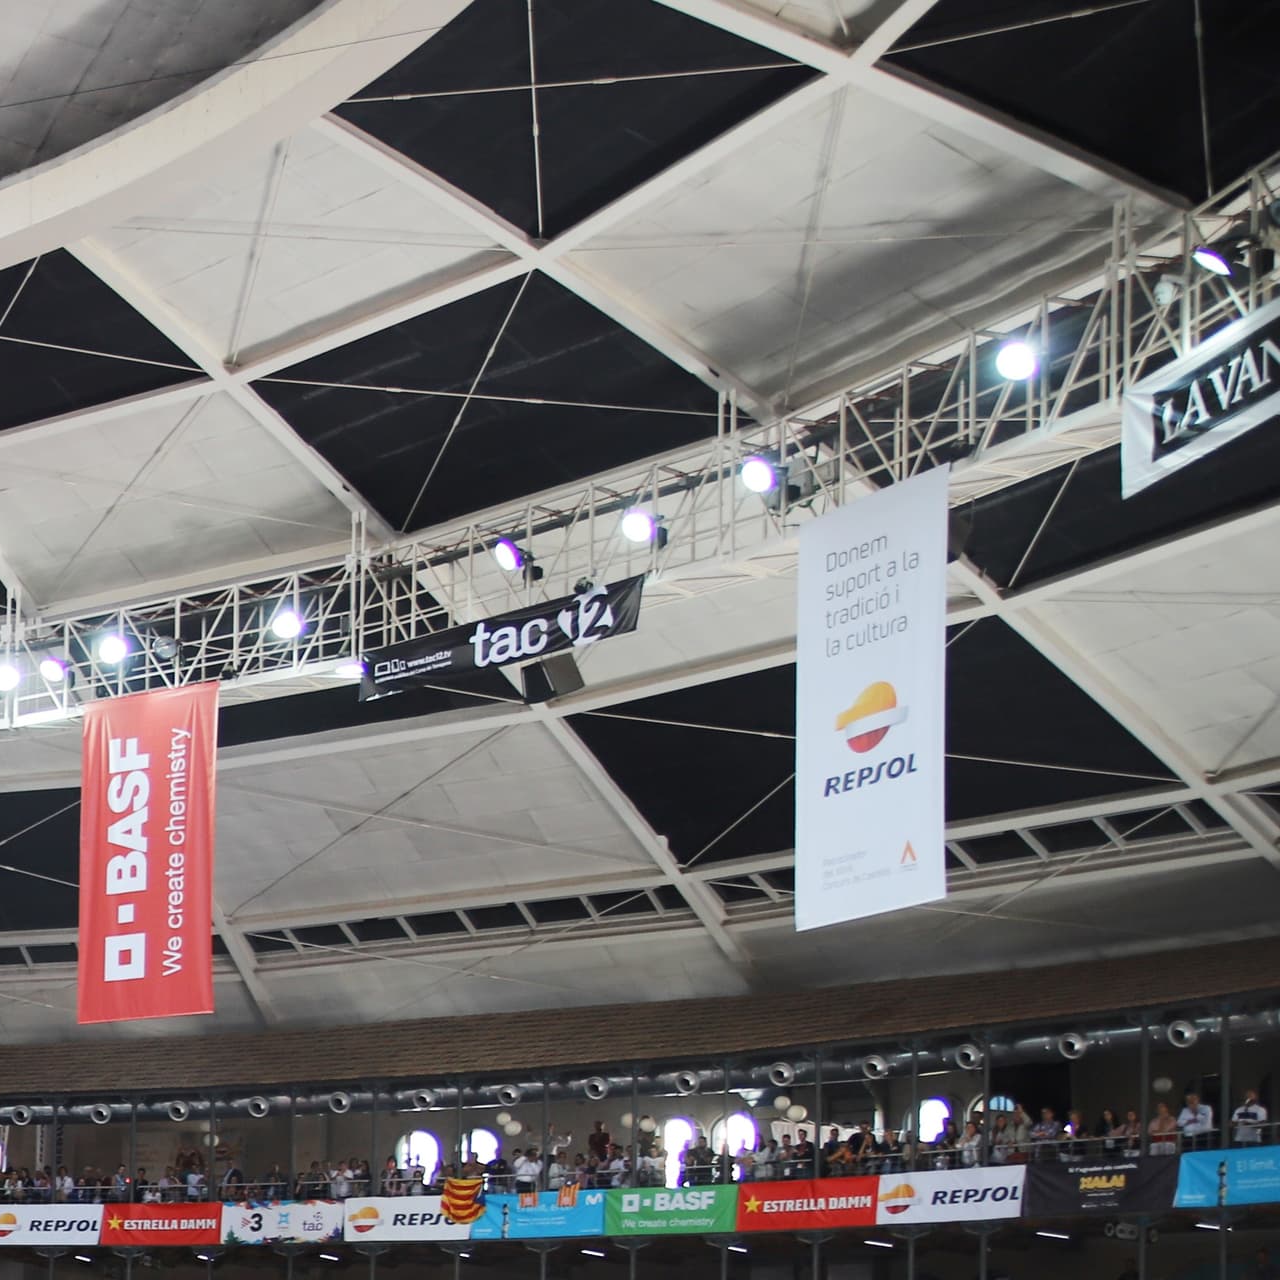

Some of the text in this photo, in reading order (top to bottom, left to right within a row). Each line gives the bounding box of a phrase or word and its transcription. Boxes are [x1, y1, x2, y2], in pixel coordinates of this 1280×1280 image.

[826, 535, 888, 573] Donem
[825, 551, 920, 602] suport a la
[826, 583, 901, 629] tradició i
[826, 614, 909, 658] la cultura
[823, 753, 918, 798] REPSOL
[106, 737, 150, 896] BASF
[162, 728, 192, 977] We create chemistry
[654, 1191, 716, 1211] BASF
[763, 1195, 872, 1213] ESTRELLA DAMM
[931, 1186, 1020, 1206] REPSOL
[29, 1219, 99, 1232] REPSOL
[124, 1218, 216, 1231] ESTRELLA DAMM
[250, 1213, 263, 1232] 3
[622, 1218, 715, 1229] We create chemistry
